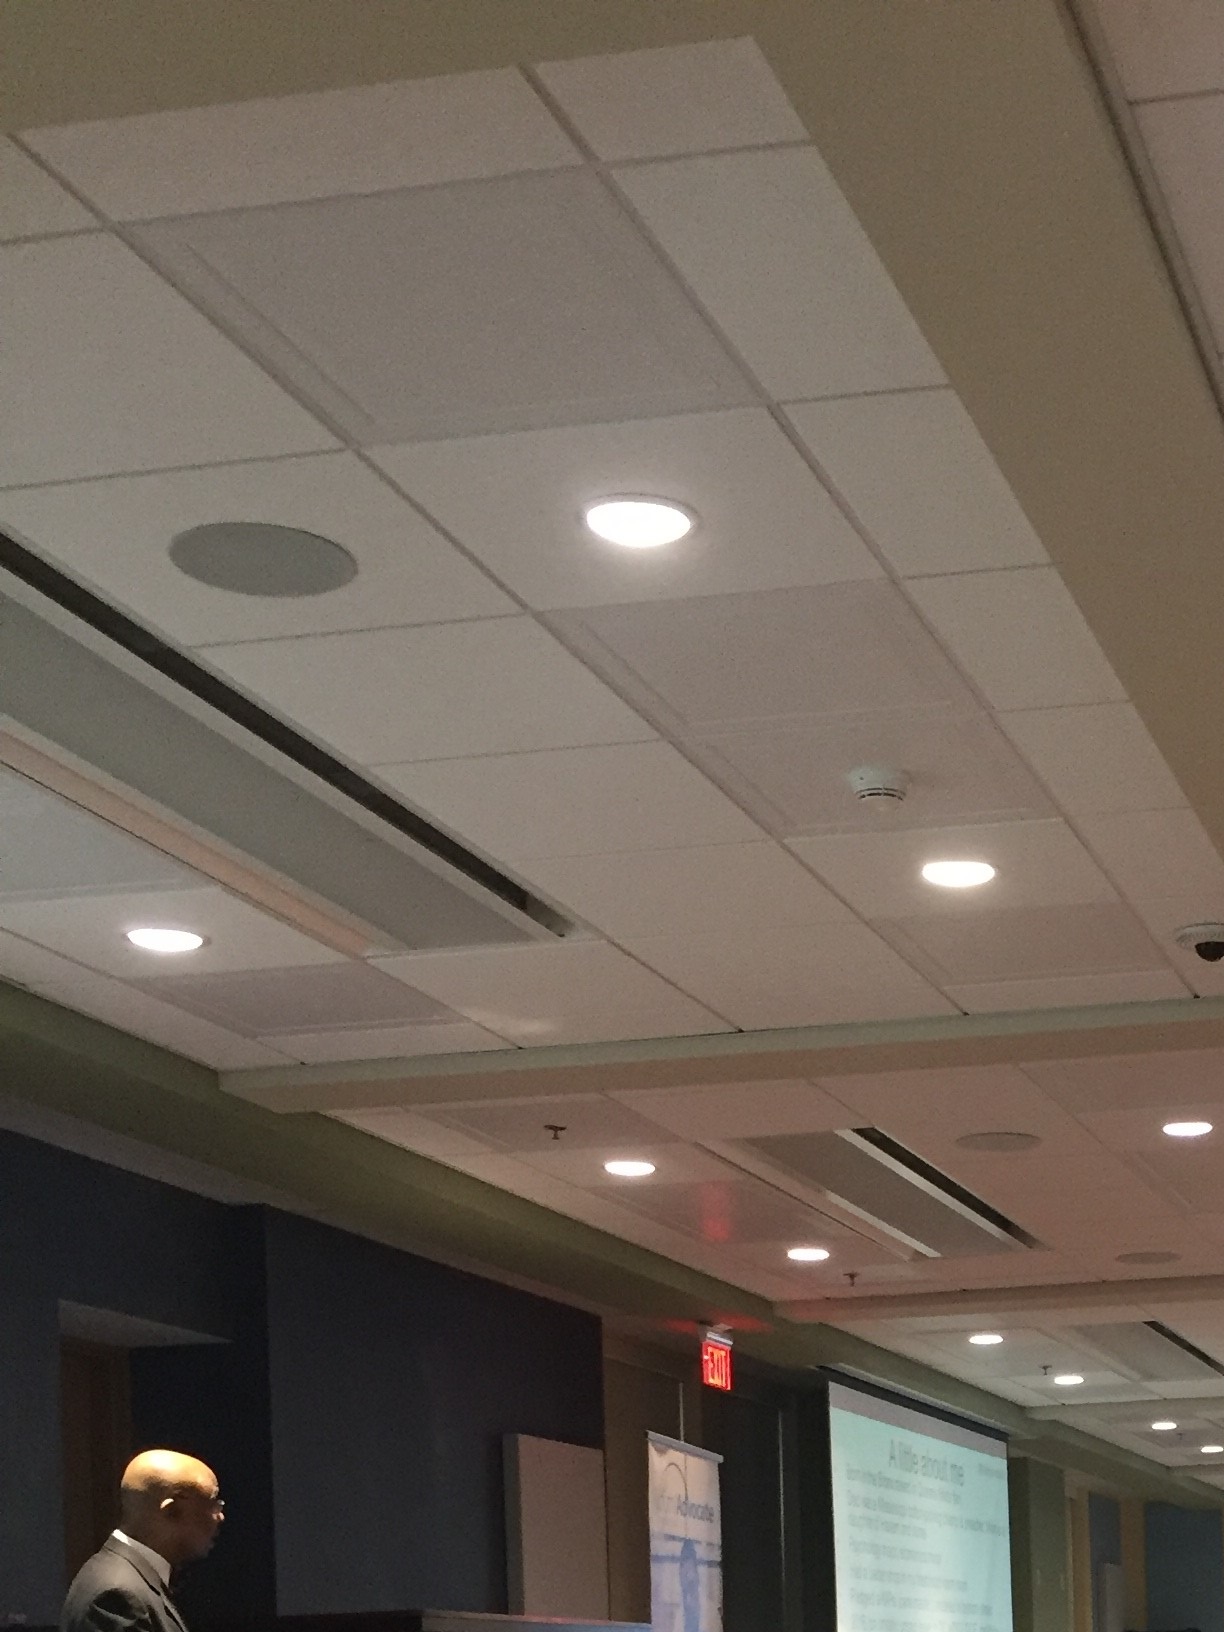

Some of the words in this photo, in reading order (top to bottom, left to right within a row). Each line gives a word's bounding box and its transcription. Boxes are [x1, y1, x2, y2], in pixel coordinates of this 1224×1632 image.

[707, 1345, 727, 1388] EXIT
[888, 1438, 897, 1468] A
[921, 1448, 948, 1482] about
[949, 1462, 965, 1487] me
